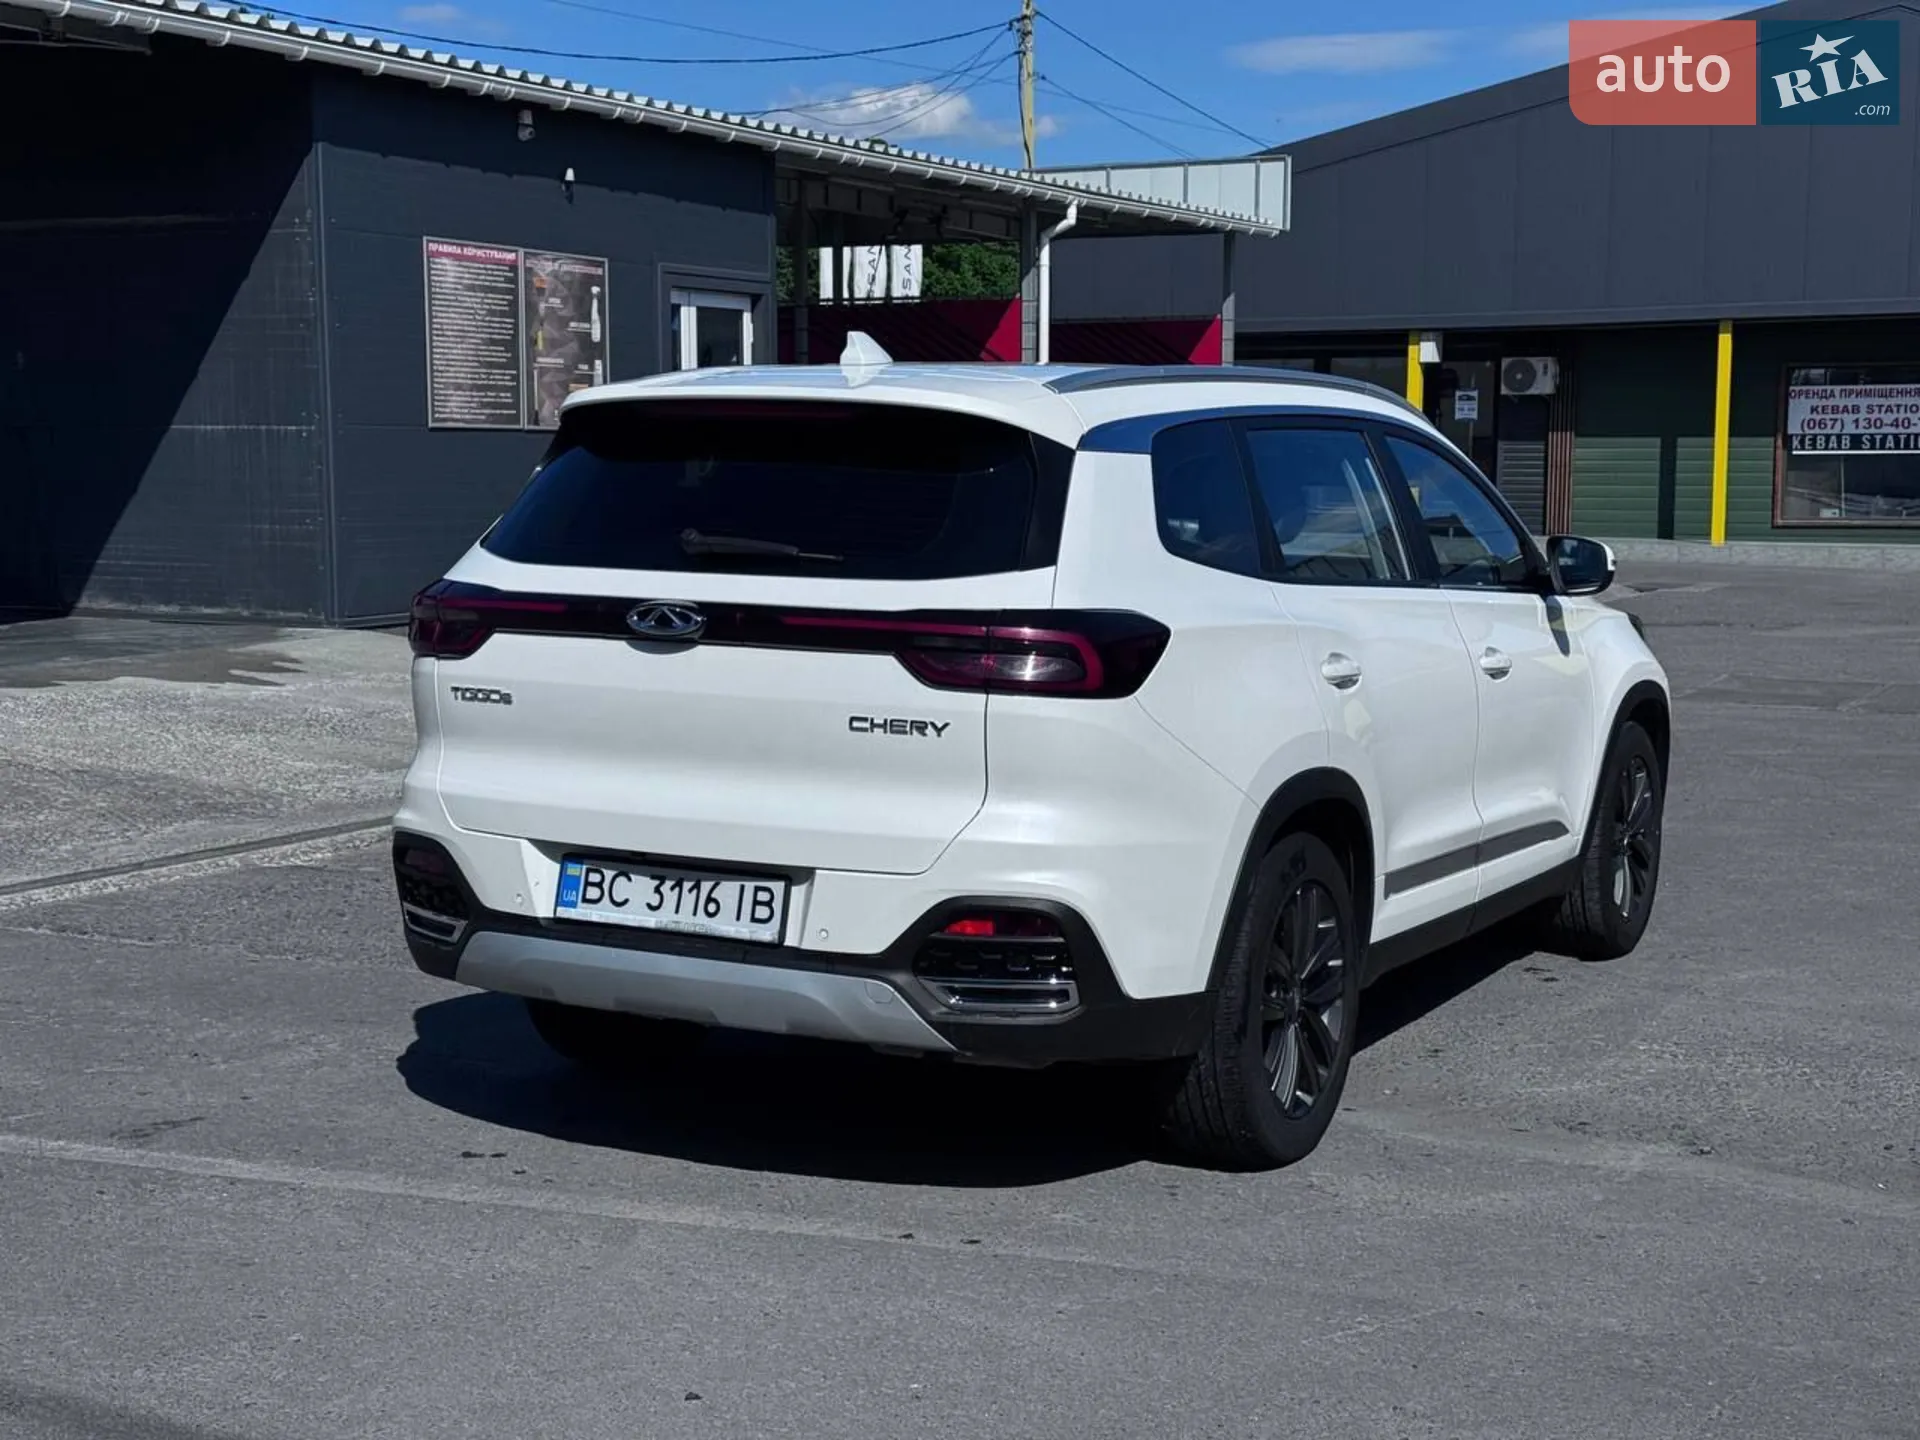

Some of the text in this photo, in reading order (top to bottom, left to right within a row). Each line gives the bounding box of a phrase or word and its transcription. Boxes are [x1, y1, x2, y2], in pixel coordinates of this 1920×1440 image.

[428, 242, 462, 255] ПРАВИЛА
[1789, 387, 1920, 400] ОРЕНДА ПРИМІЩЕННЯ
[1810, 404, 1861, 415] KEBAB
[1800, 417, 1920, 432] (067) 130-40-
[1792, 435, 1851, 450] KEBAB
[848, 716, 951, 738] CHERY
[563, 890, 577, 903] UA
[580, 866, 776, 925] BC 3116 IB
